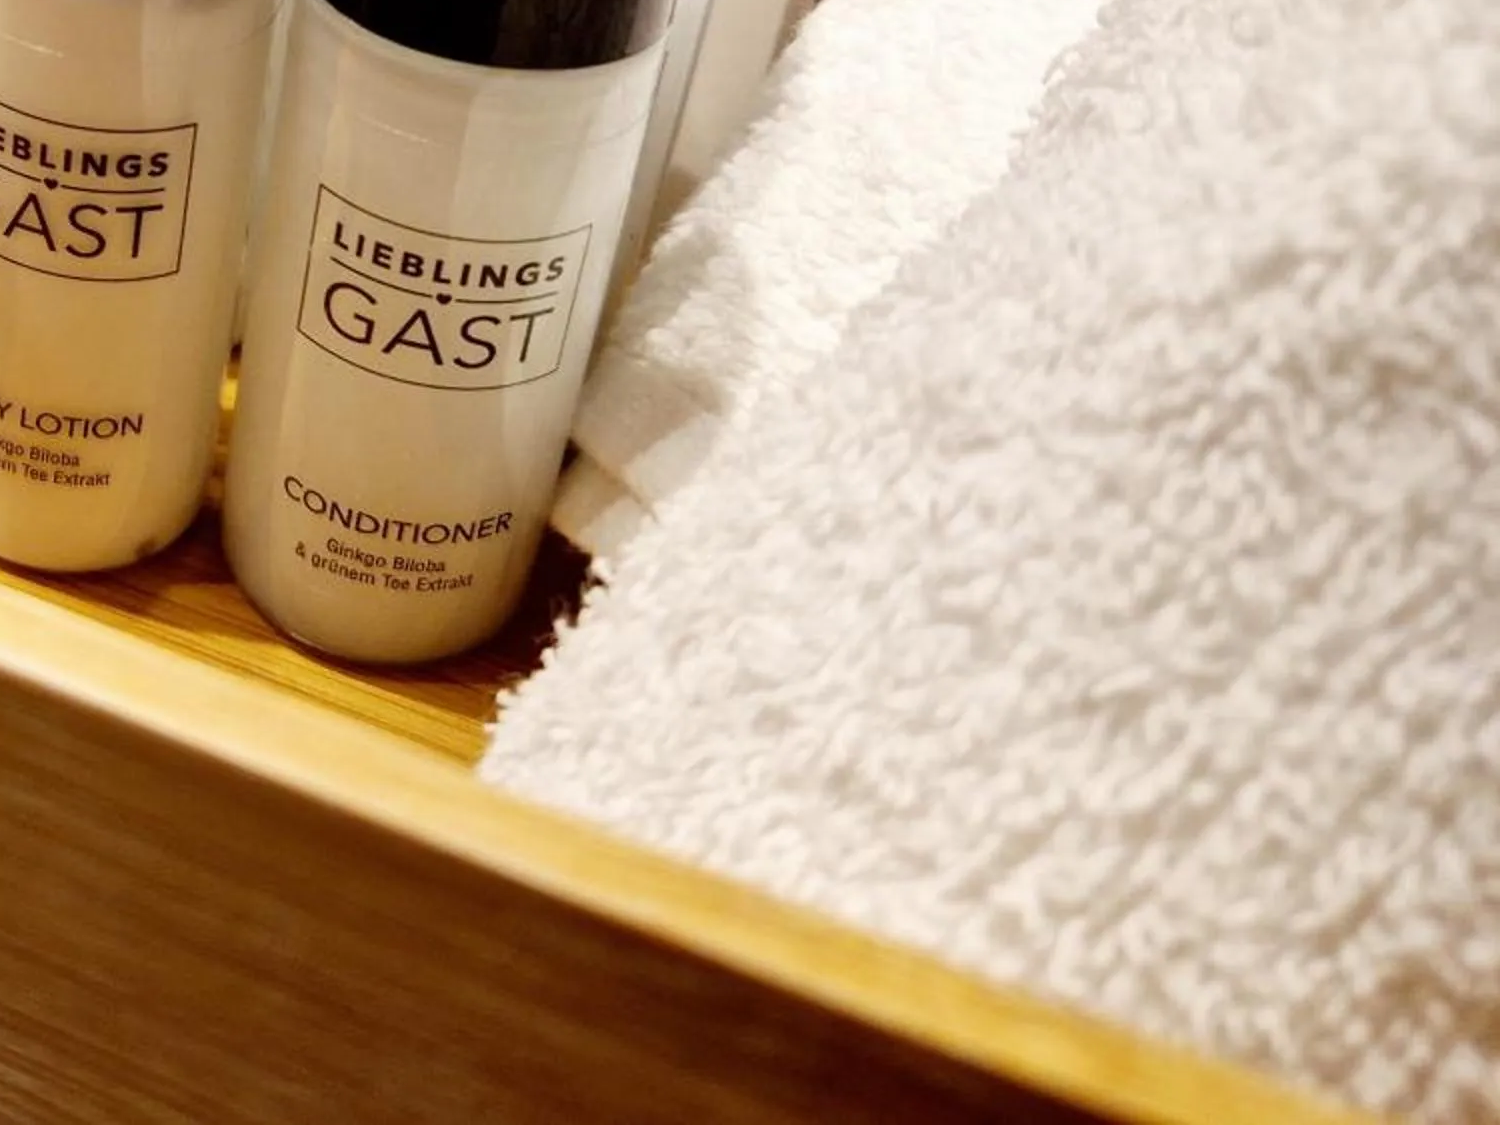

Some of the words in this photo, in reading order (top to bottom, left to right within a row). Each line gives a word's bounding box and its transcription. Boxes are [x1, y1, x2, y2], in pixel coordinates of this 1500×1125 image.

[332, 221, 566, 288] LIEBLINGS
[322, 281, 556, 370] GAST
[19, 406, 144, 439] LOTION
[21, 461, 49, 483] Tee
[52, 469, 112, 488] Extrakt
[29, 445, 80, 468] Biloba
[283, 475, 515, 545] CONDITIONER
[294, 540, 307, 559] &
[310, 553, 376, 586] grünem
[382, 574, 411, 591] Tee
[415, 574, 474, 593] Extrakt
[326, 537, 388, 569] Ginkgo
[392, 555, 446, 574] Biloba
